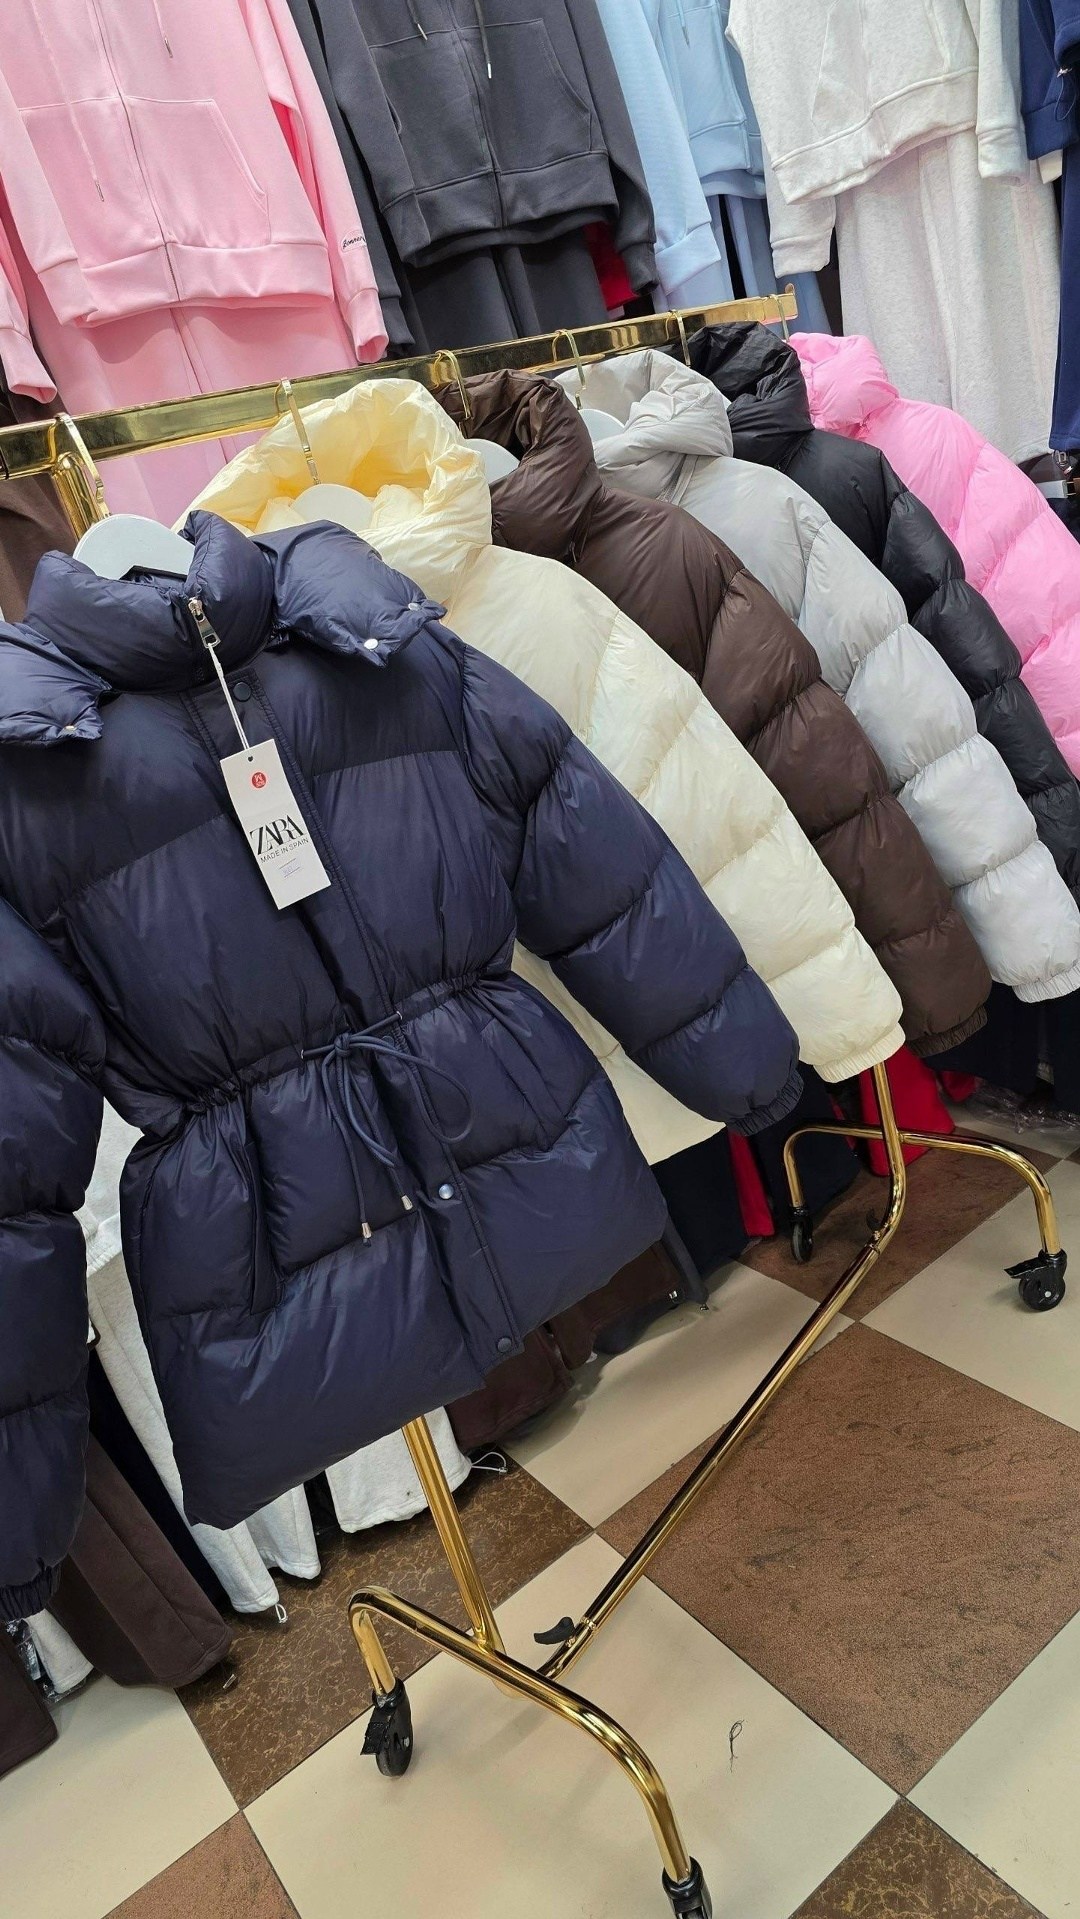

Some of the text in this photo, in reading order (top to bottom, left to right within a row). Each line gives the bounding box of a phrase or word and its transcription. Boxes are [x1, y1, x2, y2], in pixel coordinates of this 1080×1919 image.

[250, 814, 308, 855] ZARA
[260, 849, 280, 863] MADE
[289, 837, 309, 851] SPAIN
